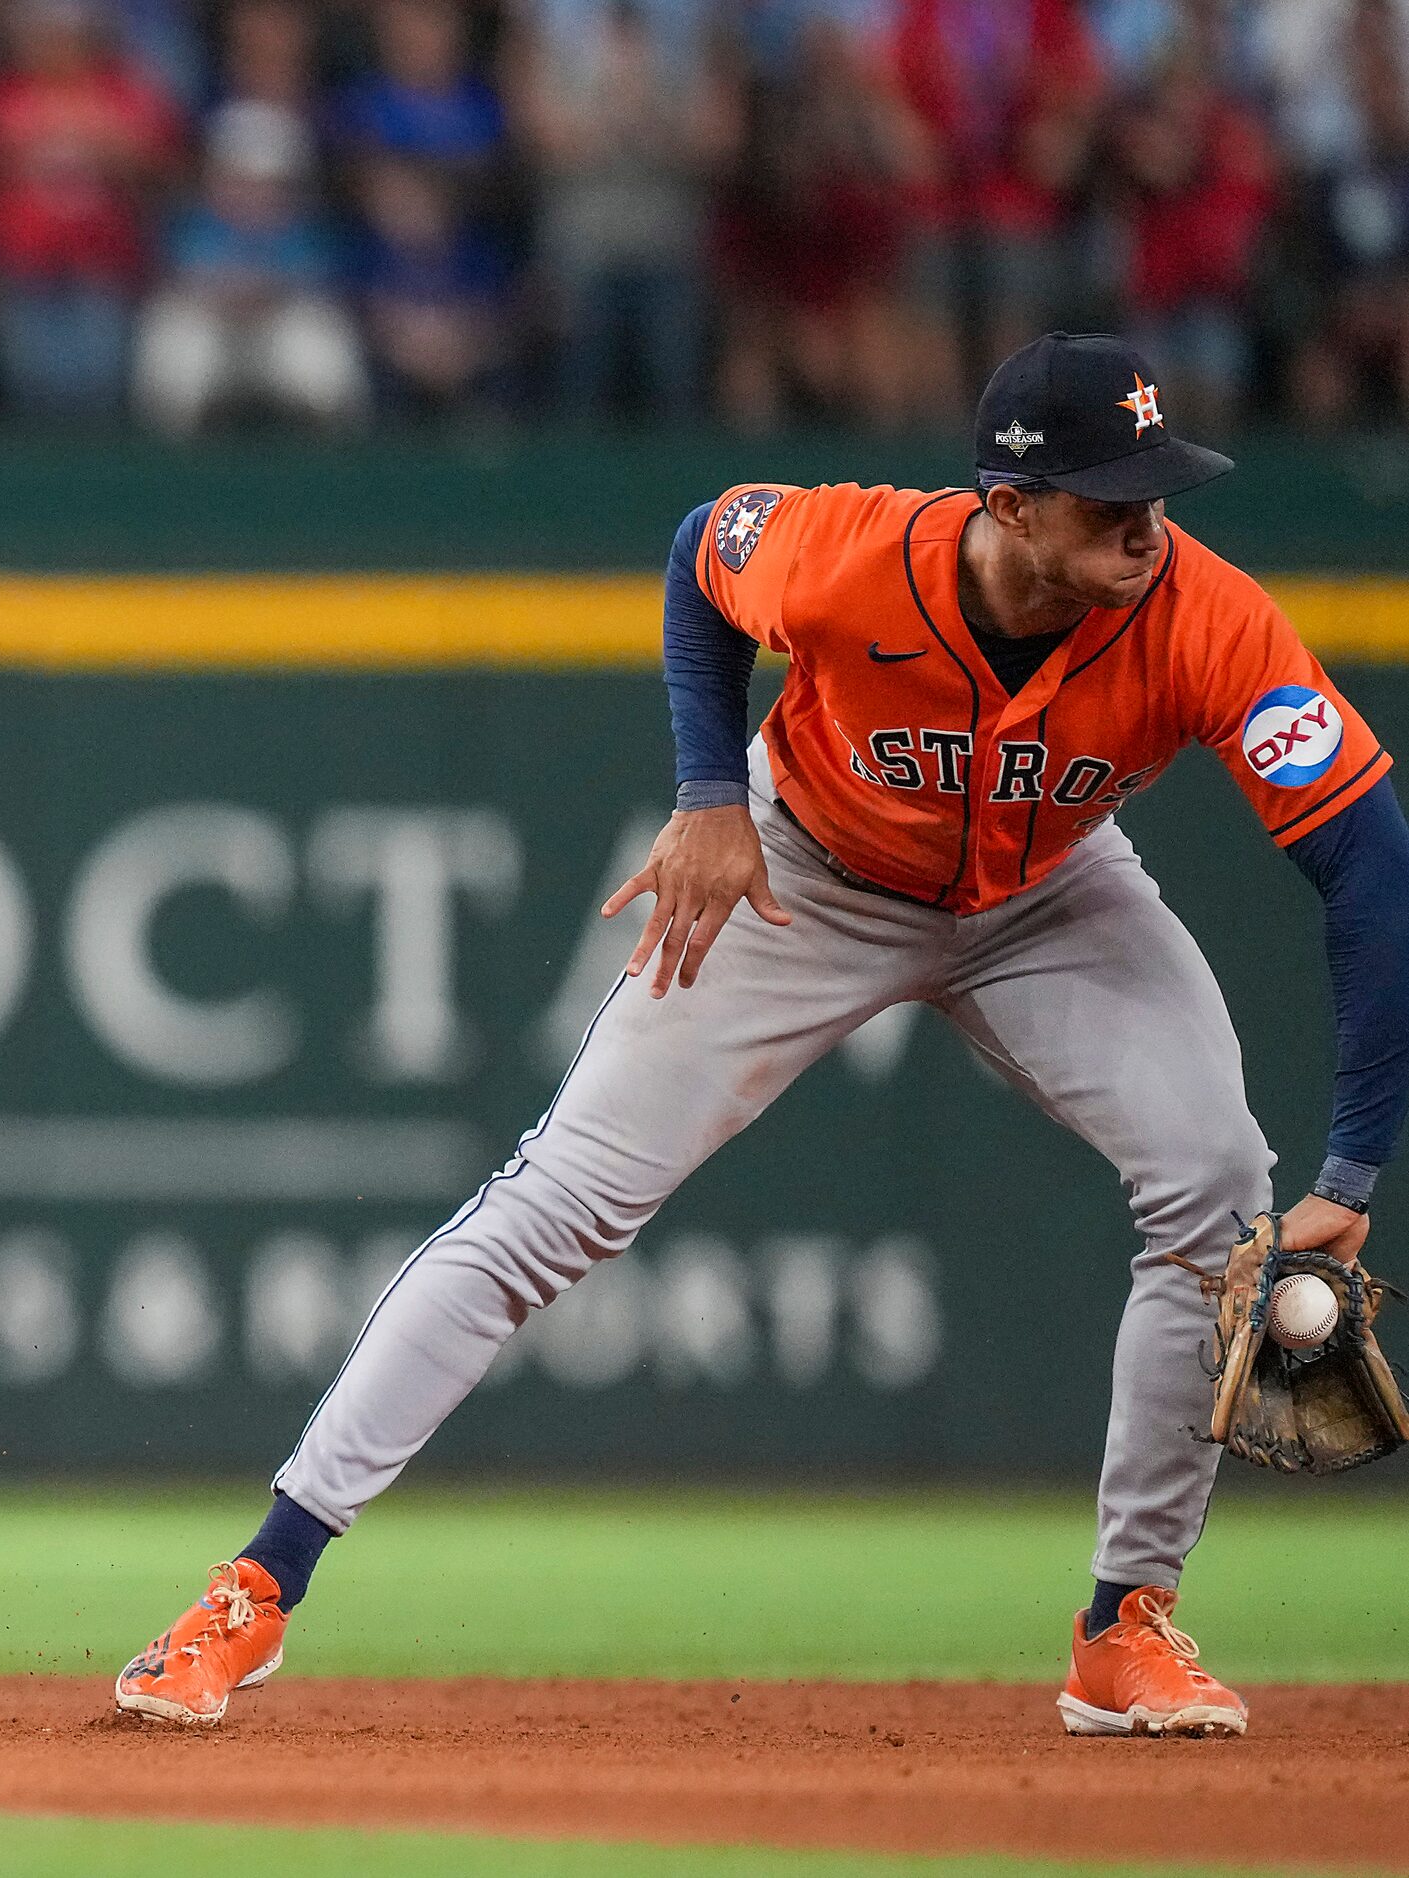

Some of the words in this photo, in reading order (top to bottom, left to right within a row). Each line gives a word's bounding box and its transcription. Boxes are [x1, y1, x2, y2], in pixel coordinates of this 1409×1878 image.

[1126, 384, 1163, 430] H
[995, 434, 1044, 444] POSTSEASON
[717, 495, 752, 551] ASTROS
[1248, 700, 1329, 771] OXY
